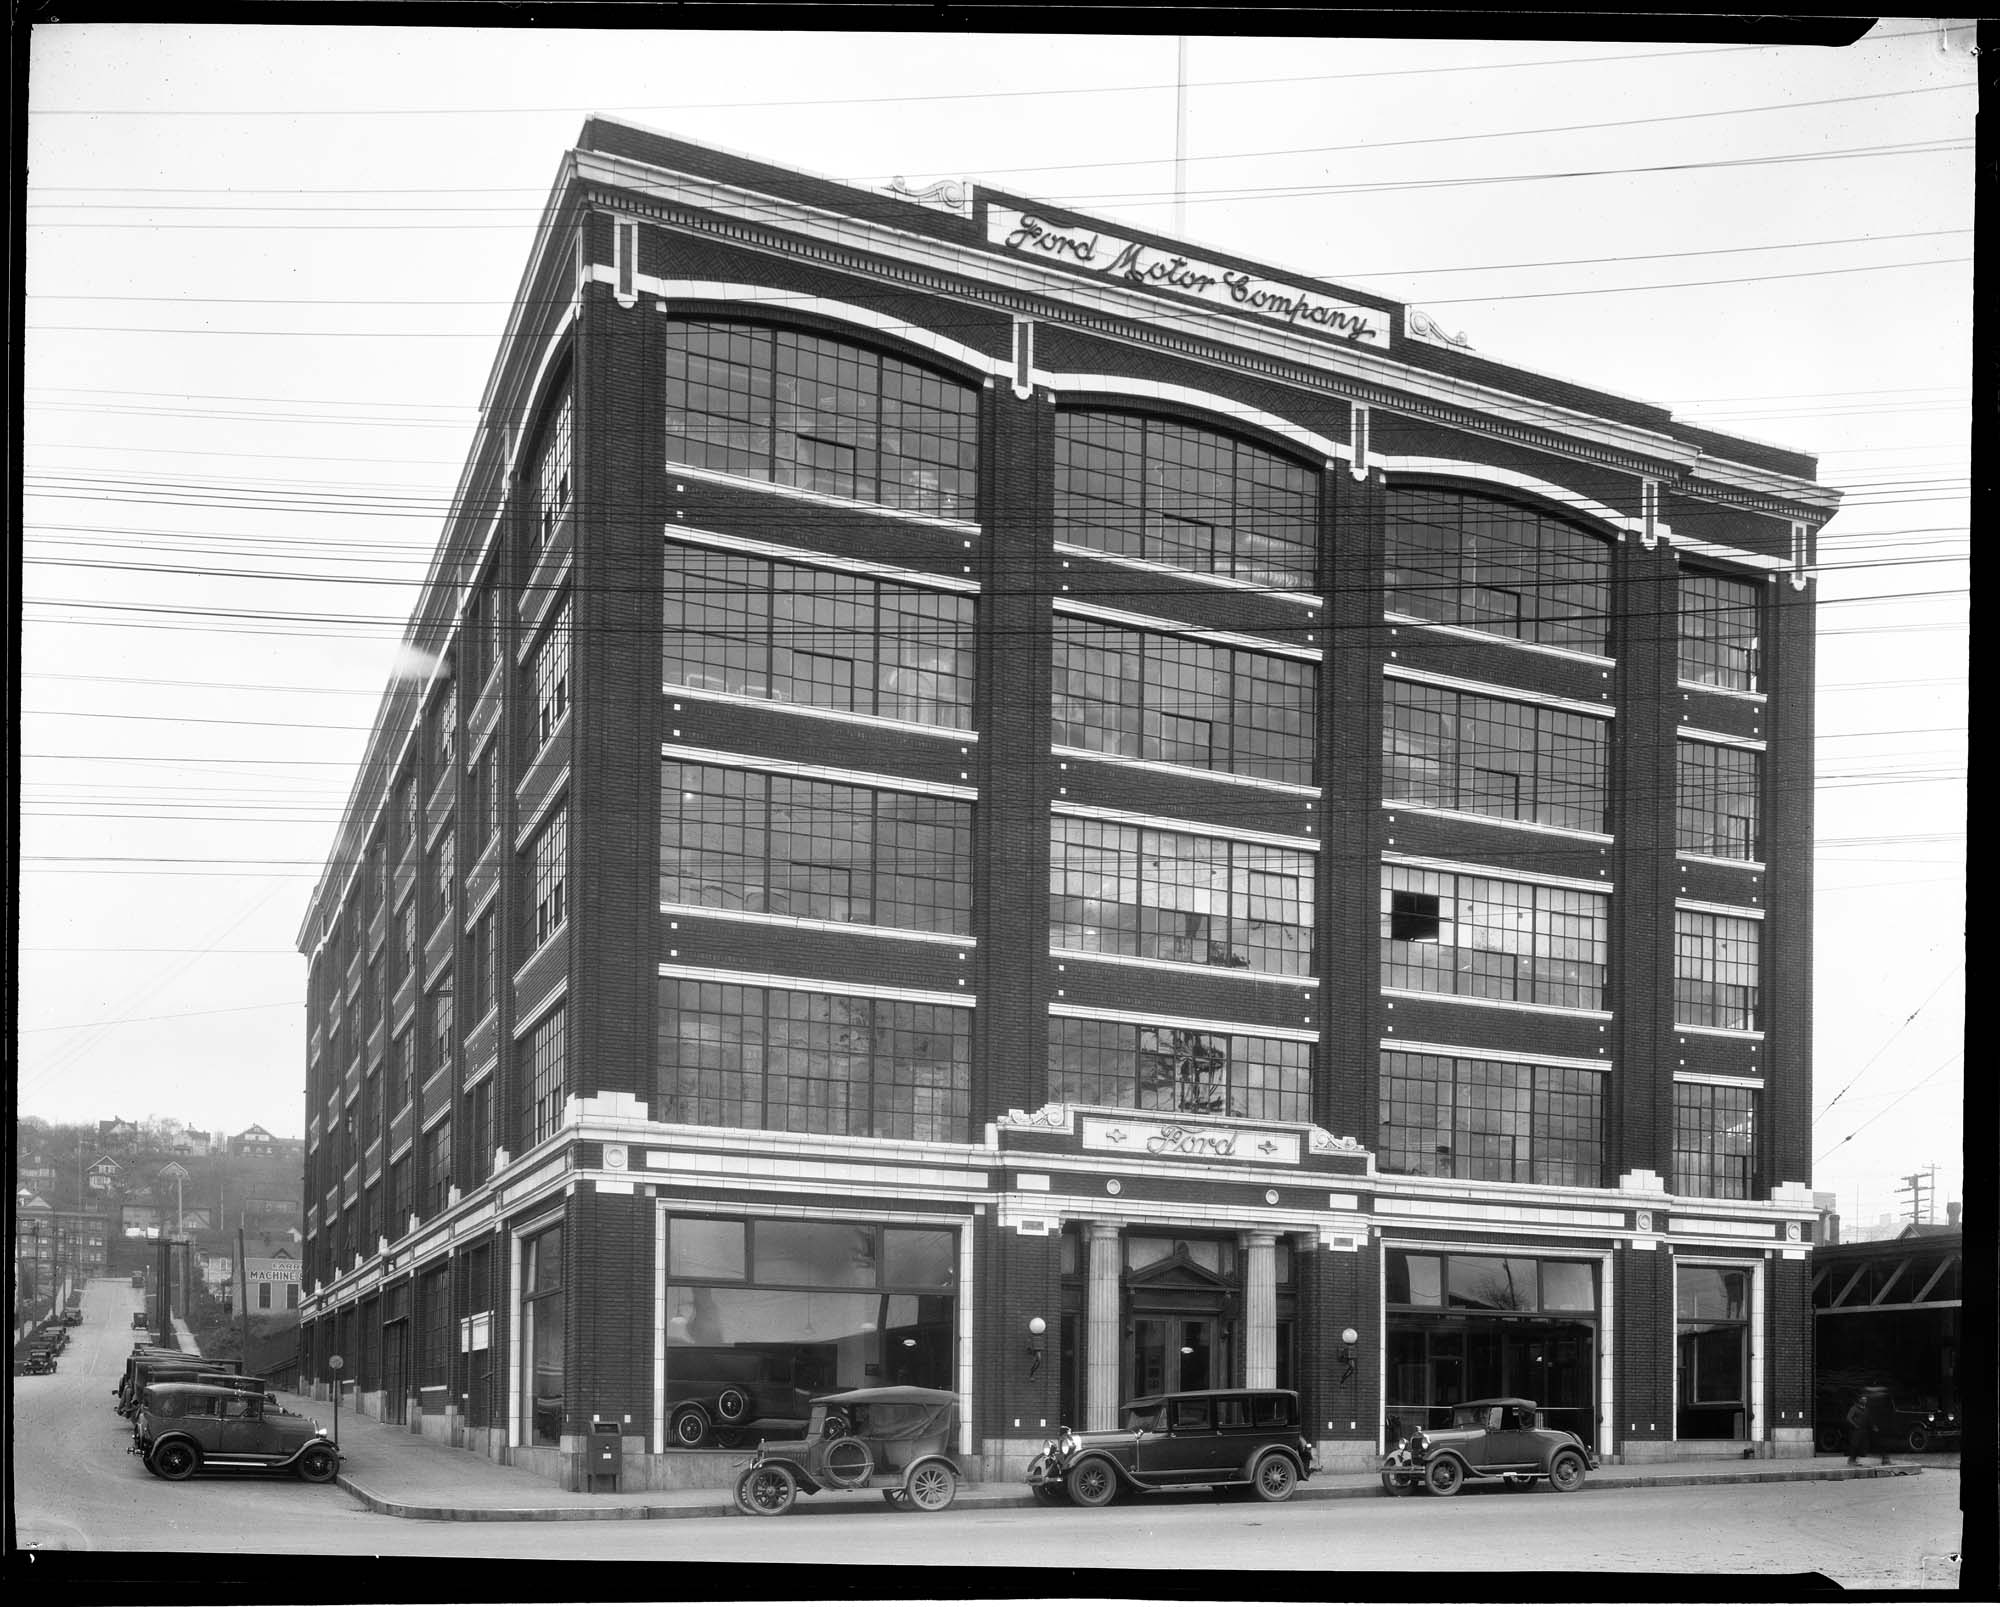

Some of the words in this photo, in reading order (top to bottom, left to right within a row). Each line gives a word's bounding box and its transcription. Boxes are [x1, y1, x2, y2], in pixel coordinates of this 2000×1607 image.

[1005, 213, 1098, 261] Ford
[1099, 242, 1215, 293] Motor
[1223, 270, 1376, 340] Company
[1146, 1125, 1239, 1156] Ford
[250, 1271, 298, 1280] MACHINE
